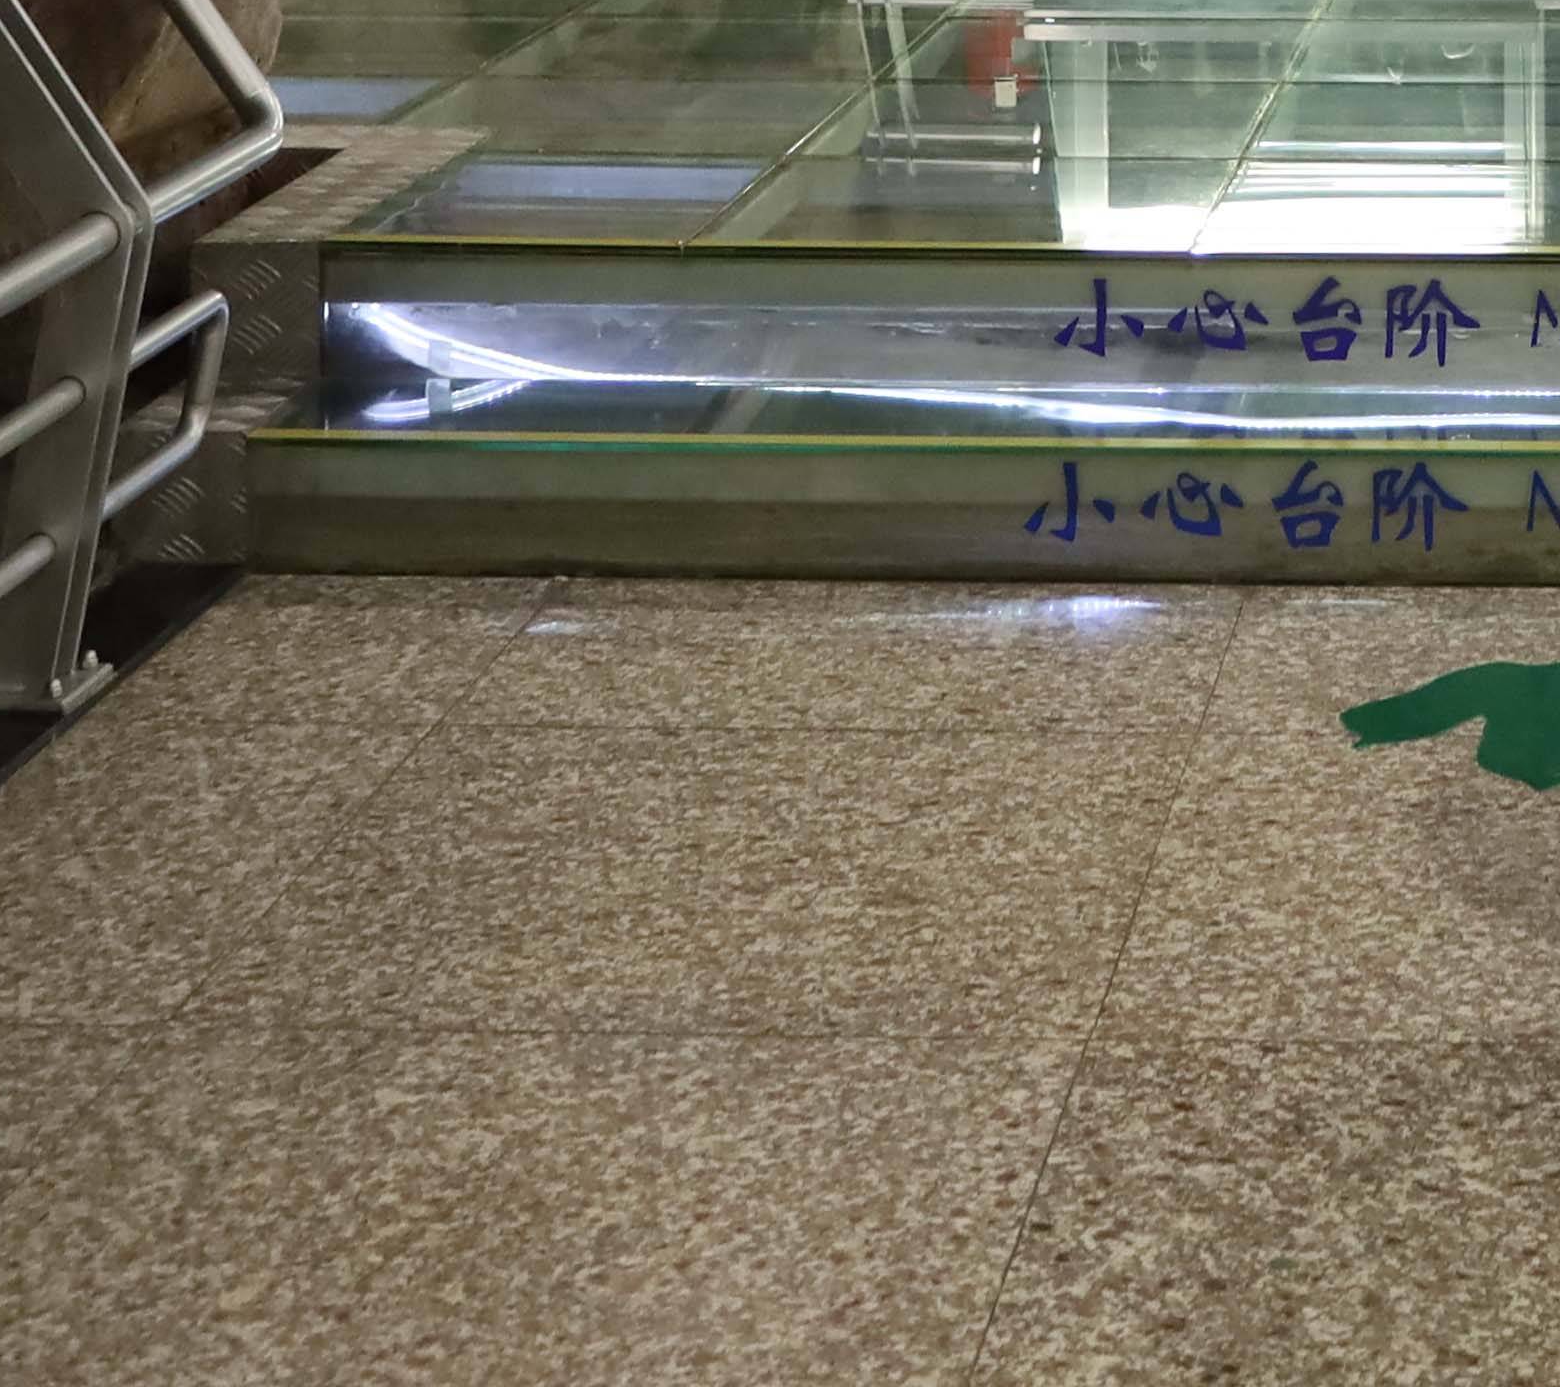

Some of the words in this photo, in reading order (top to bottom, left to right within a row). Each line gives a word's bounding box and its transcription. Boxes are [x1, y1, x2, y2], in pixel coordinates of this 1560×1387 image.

[1054, 277, 1481, 368] 小心台阶
[1023, 460, 1470, 552] 小心台阶
